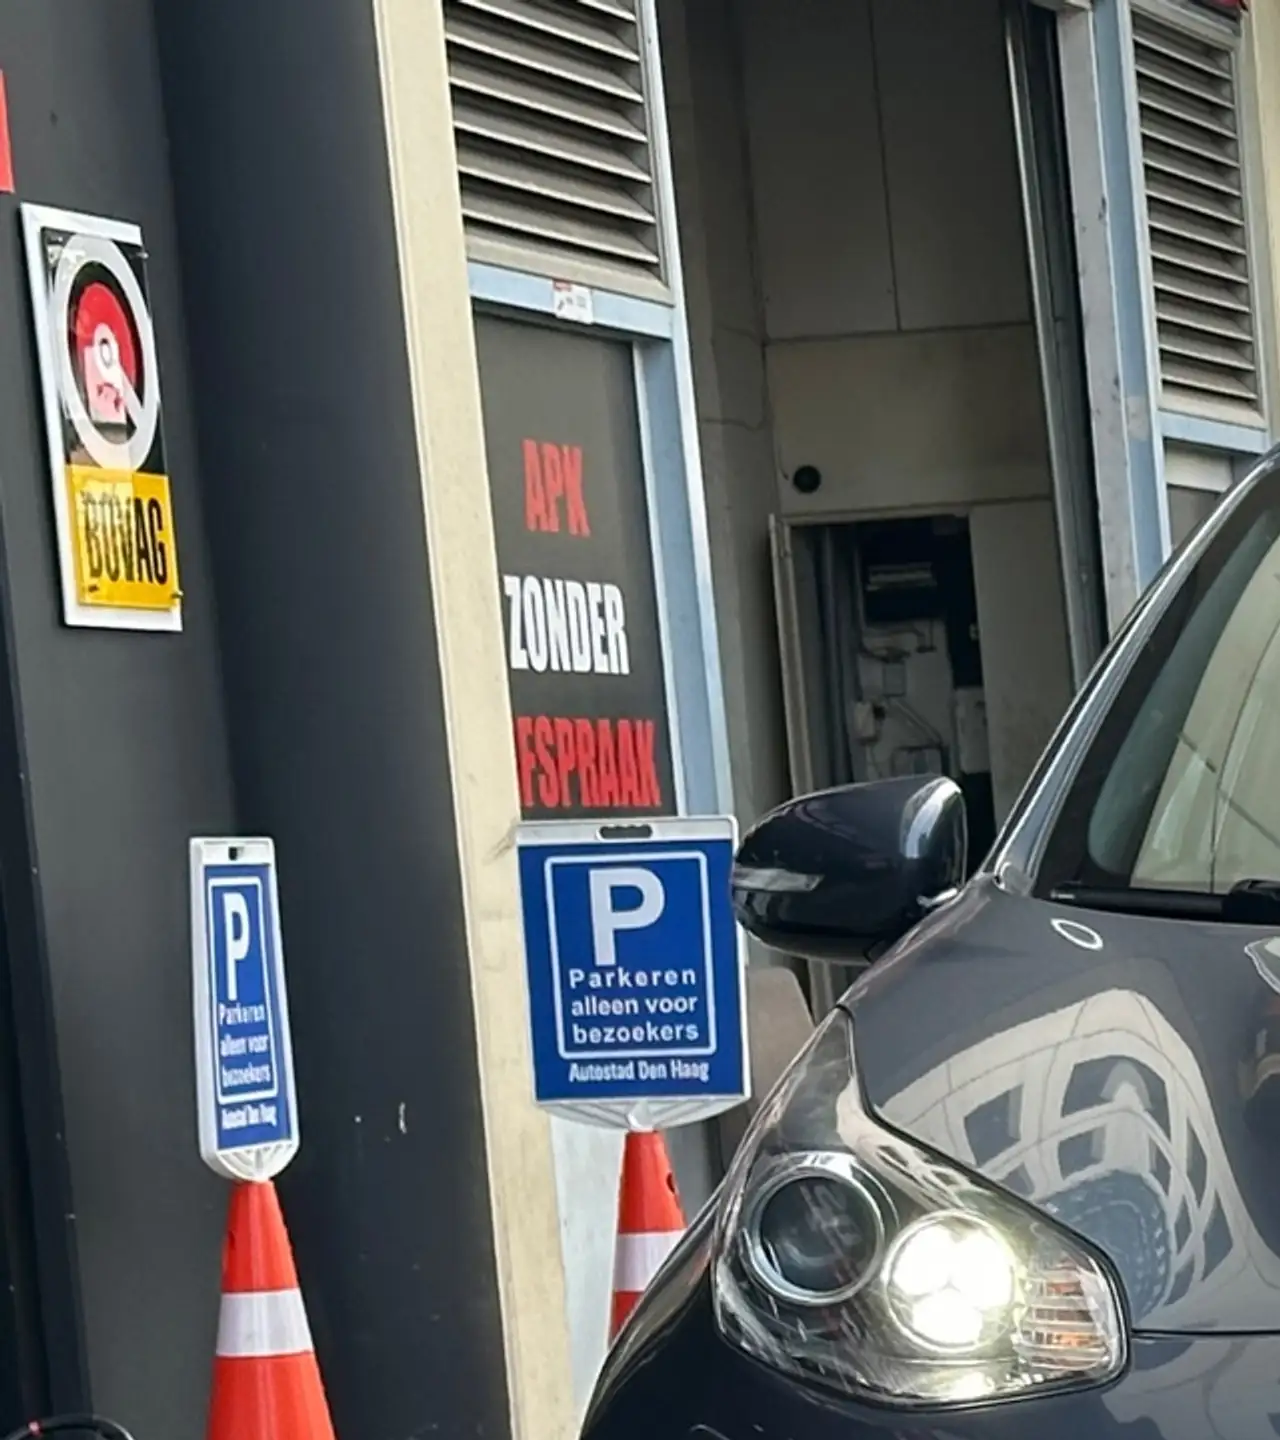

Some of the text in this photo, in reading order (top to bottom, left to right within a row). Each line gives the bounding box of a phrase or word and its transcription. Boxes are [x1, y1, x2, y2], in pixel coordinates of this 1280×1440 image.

[522, 437, 591, 538] APK
[82, 492, 168, 585] BOVAG
[503, 574, 630, 675] ZONDER
[222, 891, 250, 1000] P
[588, 867, 665, 967] P
[569, 966, 697, 990] Parkeren
[571, 996, 699, 1017] alleen voor
[569, 1059, 710, 1083] Autostad Den Haag
[572, 1020, 700, 1044] bezoekers
